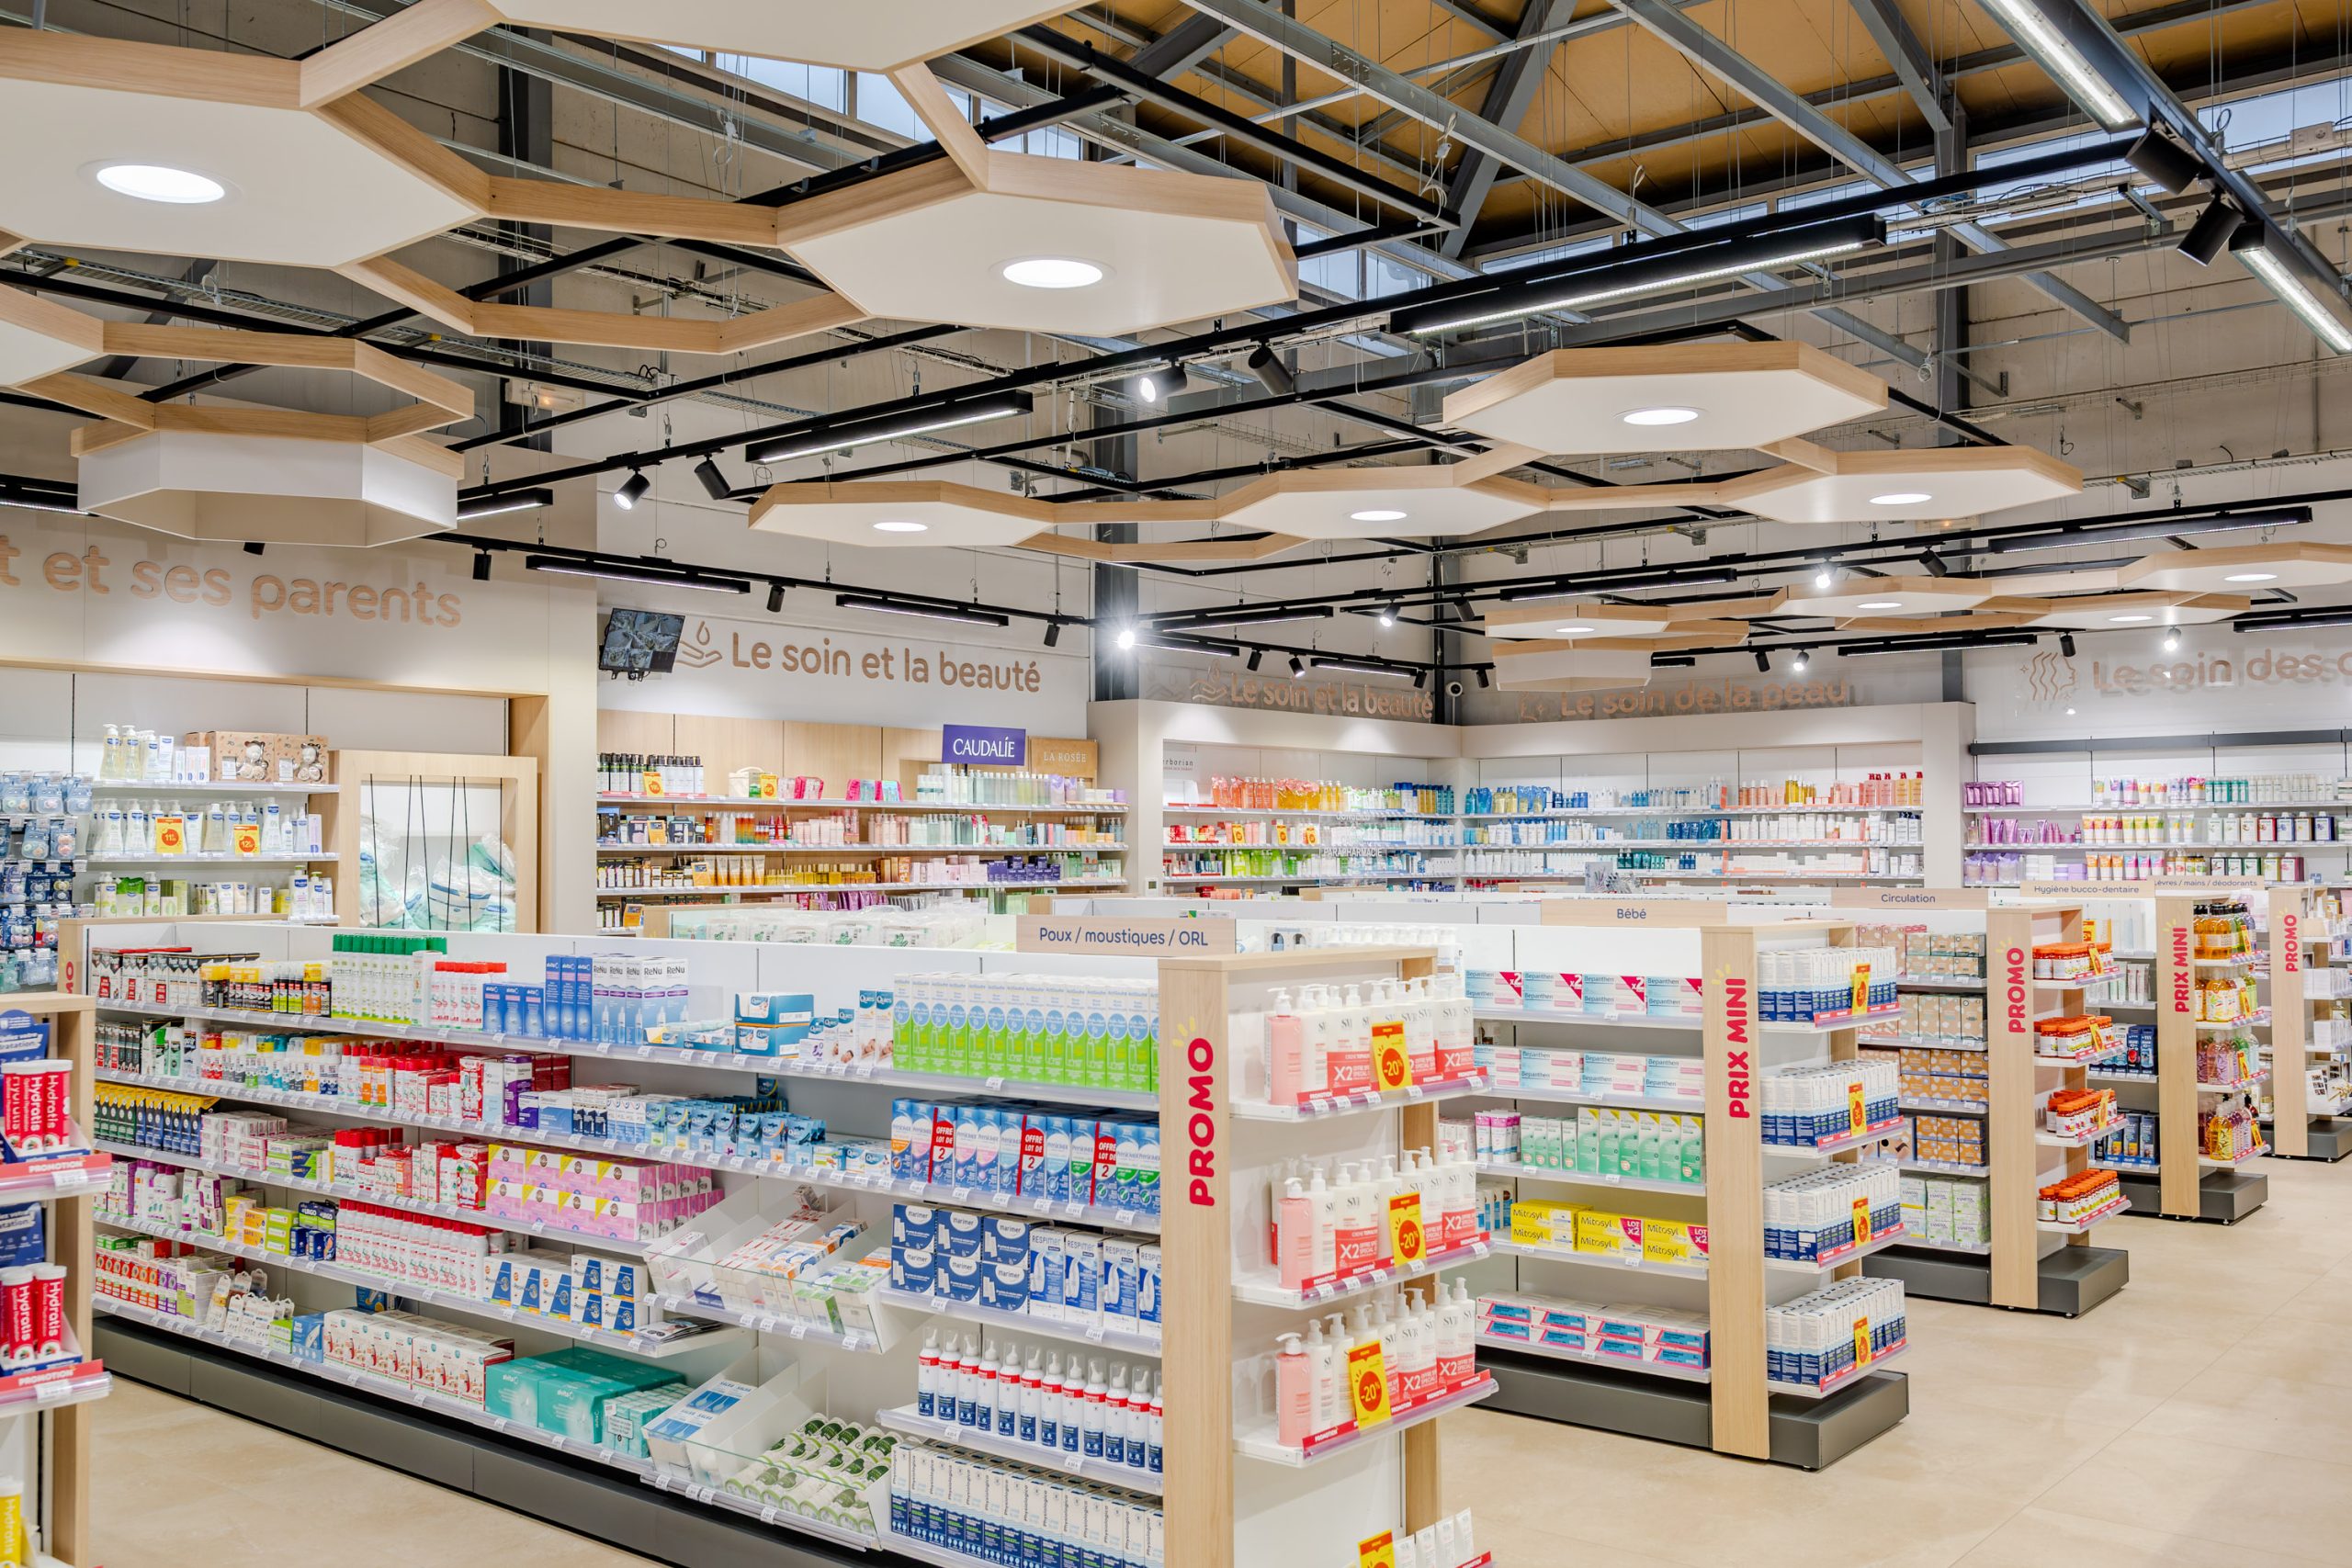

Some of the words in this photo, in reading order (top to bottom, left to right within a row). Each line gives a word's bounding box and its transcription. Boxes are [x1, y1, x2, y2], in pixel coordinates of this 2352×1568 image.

[43, 545, 110, 594] et
[130, 560, 232, 606] ses
[251, 574, 461, 627] parents
[732, 632, 772, 669] Le
[782, 637, 851, 676] soin
[862, 647, 894, 680] et
[904, 648, 929, 682] la
[939, 650, 1040, 692] beauté
[2093, 660, 2138, 689] Le
[2149, 651, 2232, 687] soin
[2246, 648, 2323, 681] des
[1231, 672, 1257, 703] Le
[1263, 680, 1308, 707] soin
[1314, 682, 1336, 710] et
[1342, 682, 1359, 713] la
[1364, 683, 1433, 718] beauté
[1562, 691, 1594, 716] Le
[1602, 689, 1665, 716] soin
[1674, 681, 1716, 710] de
[1724, 678, 1751, 707] la
[1761, 677, 1848, 709] peau
[953, 736, 1015, 758] CAUDALÍE
[1044, 751, 1055, 761] LA
[1058, 751, 1087, 762] ROSÉE
[2034, 885, 2069, 895] Hygiène
[2071, 885, 2140, 893] bucco-dentaire
[1881, 893, 1936, 903] Circulation
[1616, 907, 1646, 919] Bébé
[1039, 927, 1072, 942] Poux
[1075, 927, 1082, 943] /
[1085, 929, 1165, 946] moustiques
[1169, 929, 1175, 946] /
[1179, 931, 1208, 946] ORL
[2283, 914, 2299, 972] PROMO
[2173, 927, 2188, 965] MINI
[666, 965, 684, 974] ReNu
[2007, 947, 2026, 1033] PROMO
[2174, 972, 2190, 1012] PRIX
[1725, 978, 1748, 1043] MINI
[1444, 1053, 1461, 1066] X2
[1334, 1066, 1352, 1081] X2
[1384, 1059, 1403, 1077] -20%
[1727, 1051, 1750, 1118] PRIX
[30, 1077, 43, 1132] Hydratis
[47, 1074, 59, 1130] Hydratis
[1188, 1037, 1216, 1206] PROMO
[935, 1126, 953, 1135] OFFRE
[1024, 1134, 1043, 1144] OFFRE
[938, 1147, 945, 1159] 2
[1099, 1142, 1116, 1152] OFFRE
[28, 1162, 84, 1174] PROMOTION
[1028, 1156, 1035, 1168] 2
[1102, 1165, 1110, 1178] 2
[908, 1211, 928, 1219] marimer
[953, 1217, 974, 1225] marimer
[1513, 1209, 1544, 1219] Mitosyl
[1000, 1224, 1022, 1233] marimer
[1444, 1215, 1462, 1230] X2
[1581, 1217, 1612, 1228] Mitosyl
[1647, 1224, 1679, 1235] Mitosyl
[1514, 1228, 1544, 1239] Mitosyl
[1694, 1227, 1707, 1235] LOT
[1401, 1230, 1419, 1249] -20%
[1581, 1236, 1612, 1248] Mitosyl
[1340, 1244, 1360, 1259] X2
[1647, 1245, 1679, 1257] Mitosyl
[907, 1255, 928, 1263] marimer
[952, 1261, 973, 1270] marimer
[998, 1269, 1021, 1278] marimer
[18, 1285, 33, 1341] Hydratis
[49, 1280, 62, 1337] Hydratis
[1439, 1361, 1457, 1377] X2
[17, 1370, 74, 1386] PROMOTION
[1403, 1375, 1421, 1391] X2
[1361, 1380, 1382, 1402] -20%
